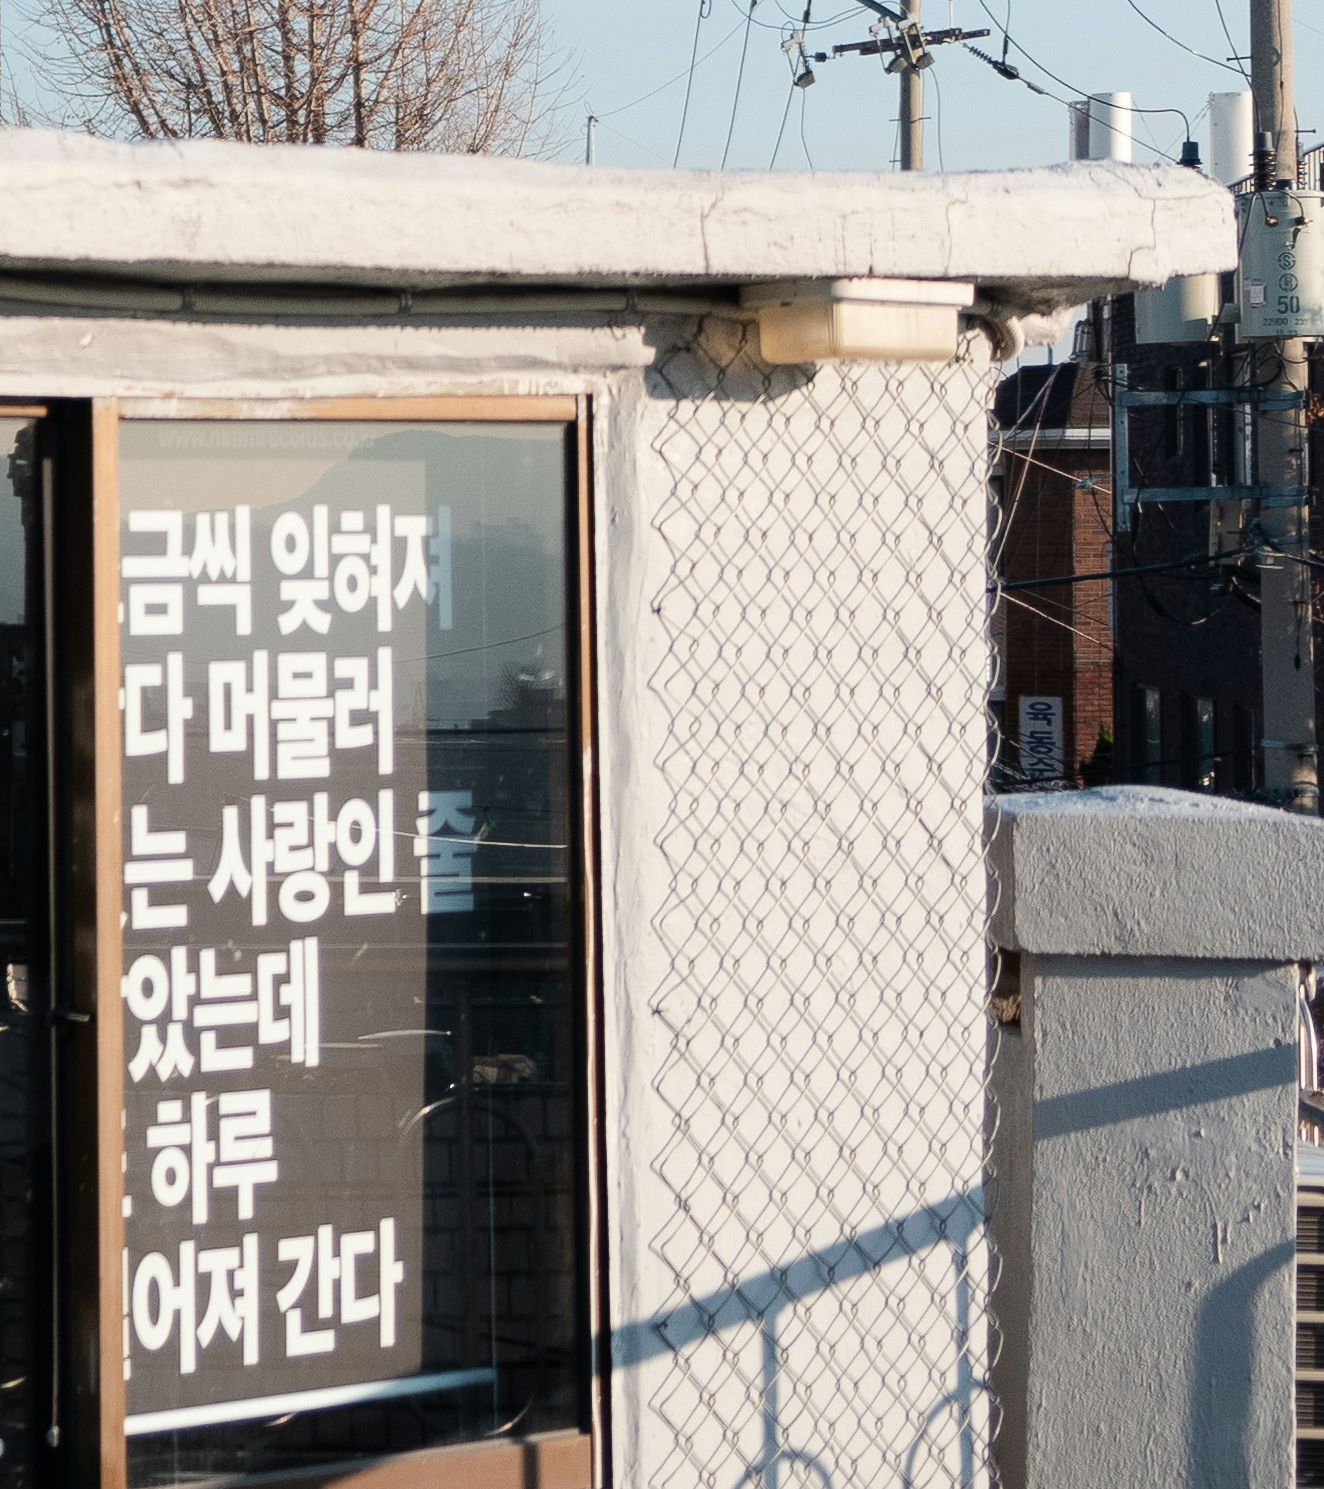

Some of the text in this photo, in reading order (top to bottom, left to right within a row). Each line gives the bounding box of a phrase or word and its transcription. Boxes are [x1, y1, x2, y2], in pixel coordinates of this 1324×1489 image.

[1277, 296, 1300, 314] 50
[118, 503, 453, 636] 금씩 잊혀져
[119, 645, 394, 784] 다 머물러
[120, 788, 478, 930] 는 사랑인 줄
[120, 936, 319, 1084] 았는데
[147, 1088, 278, 1225] 하루
[122, 1217, 403, 1381] 어져 간다
